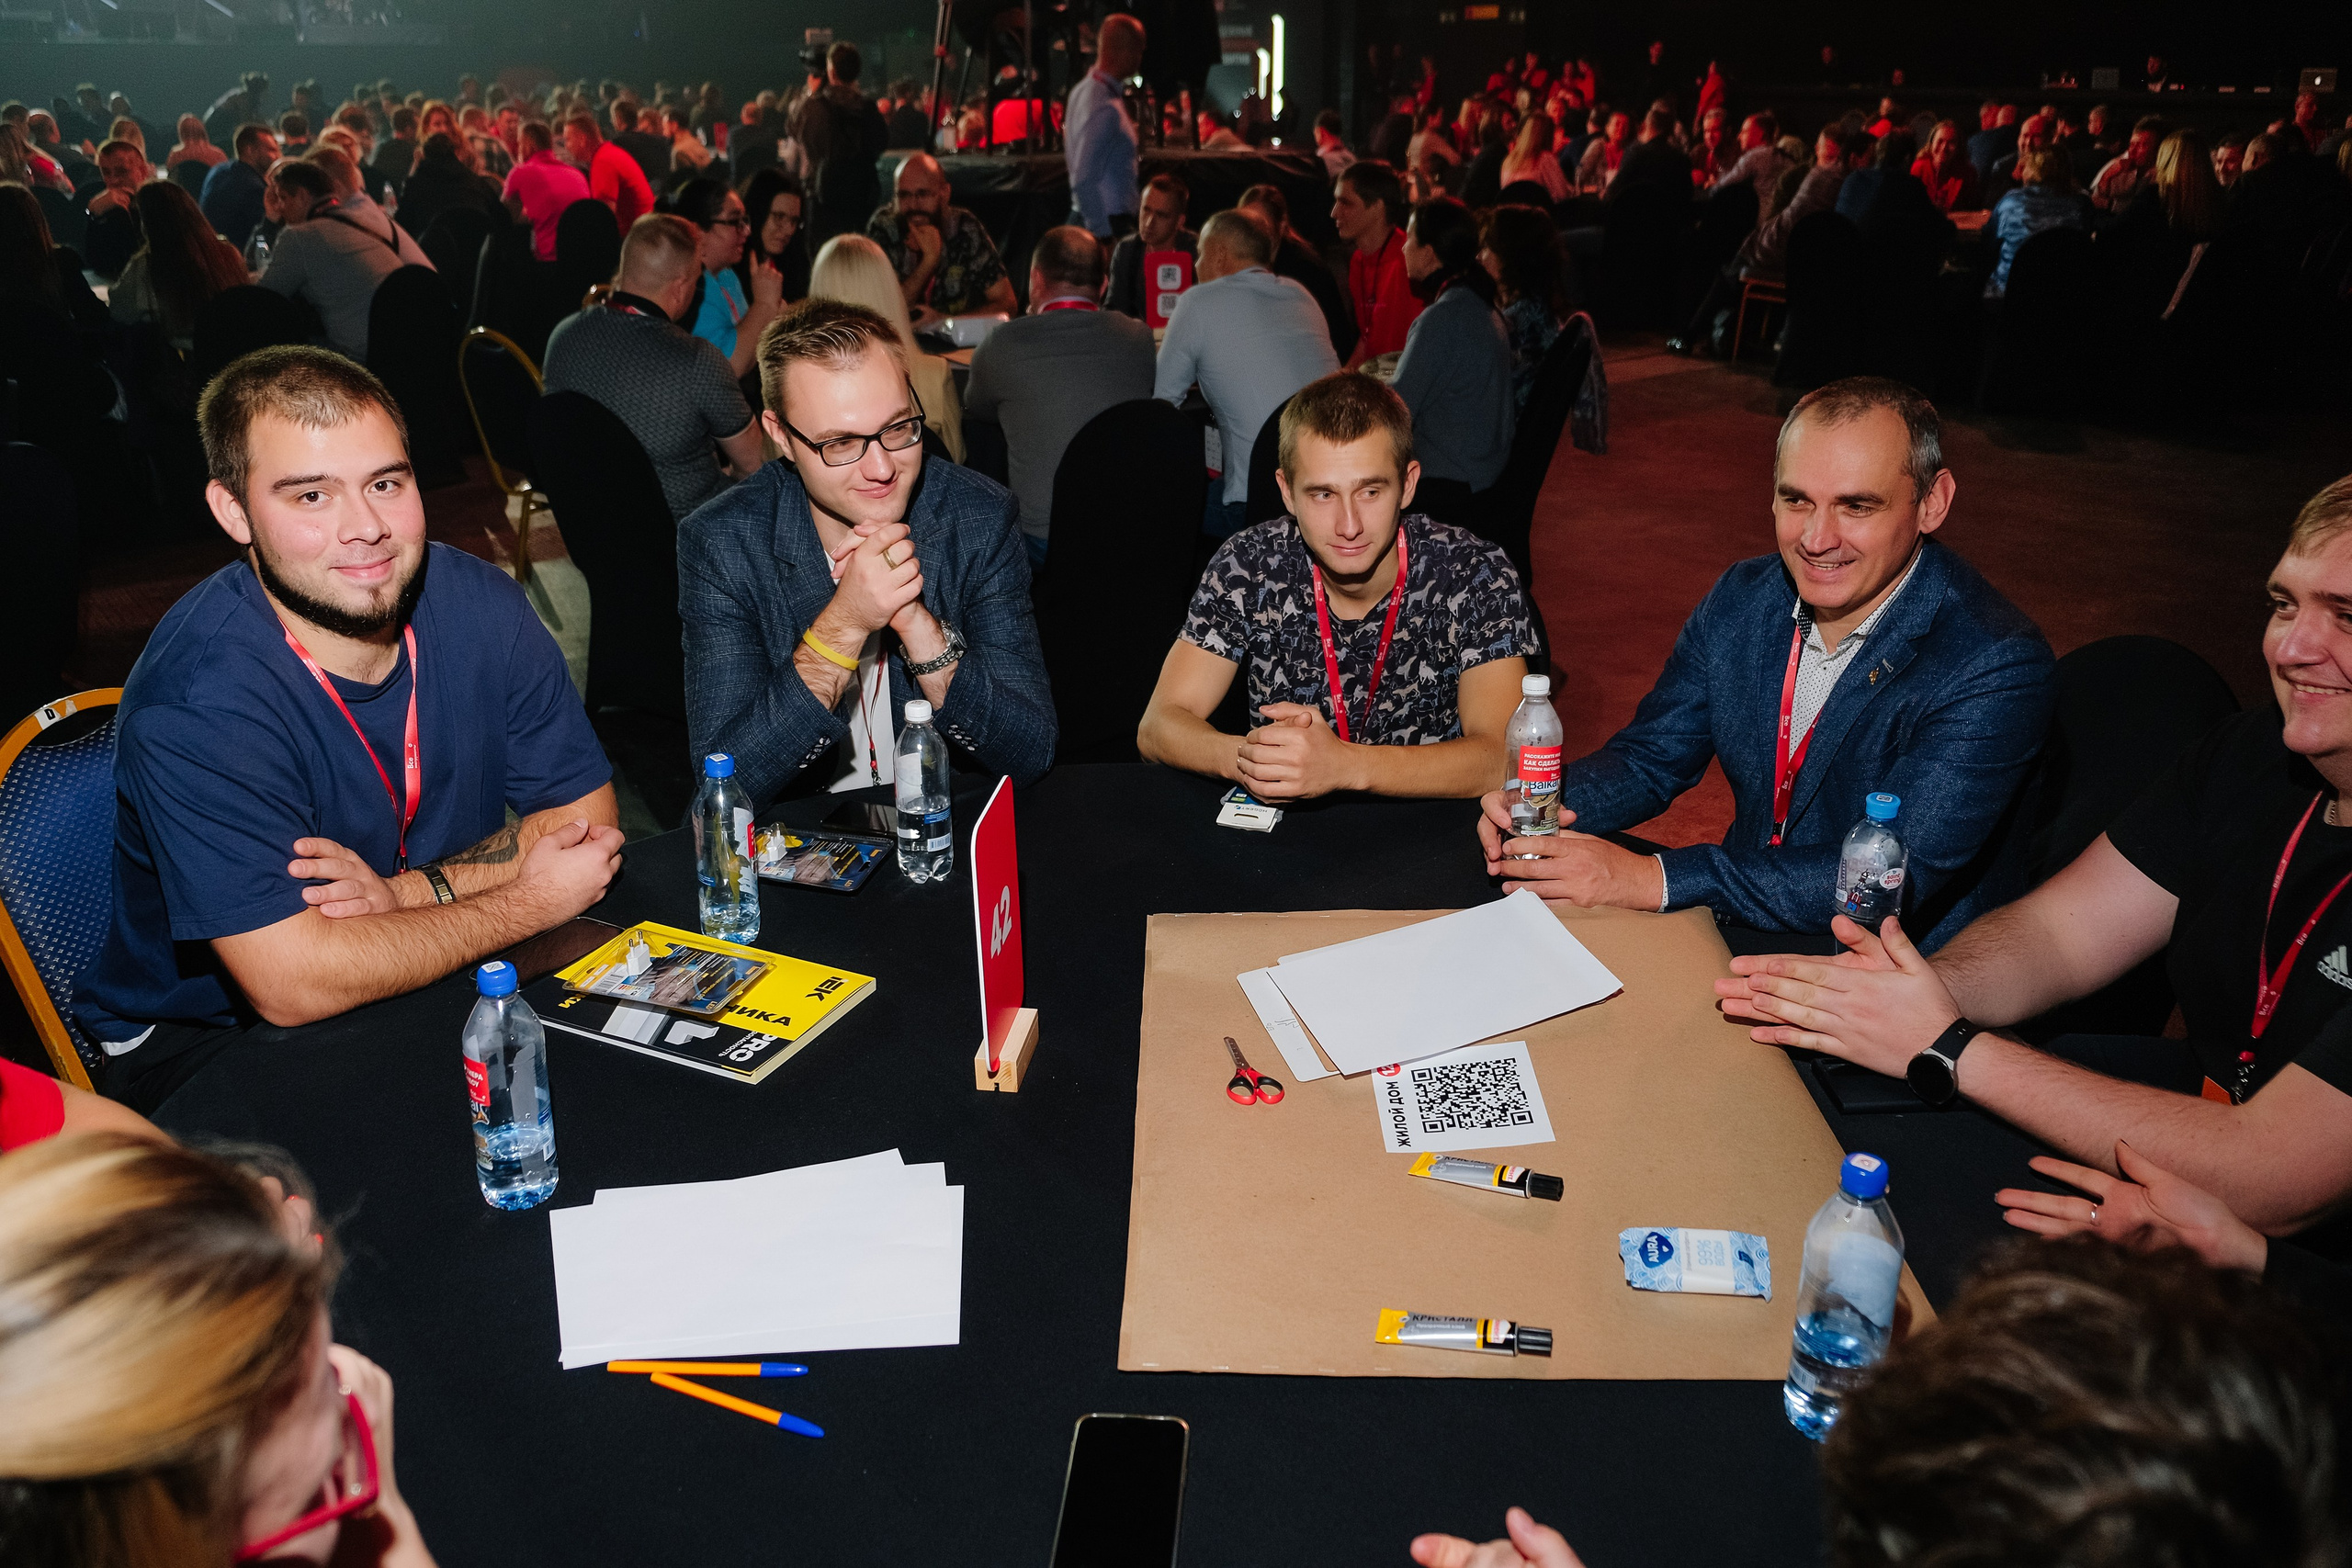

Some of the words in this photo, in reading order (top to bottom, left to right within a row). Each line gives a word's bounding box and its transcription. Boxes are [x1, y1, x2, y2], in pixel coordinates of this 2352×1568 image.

[989, 885, 1012, 960] 42
[723, 1004, 792, 1027] НИКА
[1386, 1081, 1404, 1105] ДОМ
[1388, 1108, 1412, 1147] ЖИЛОЙ
[1647, 1235, 1660, 1263] AURA
